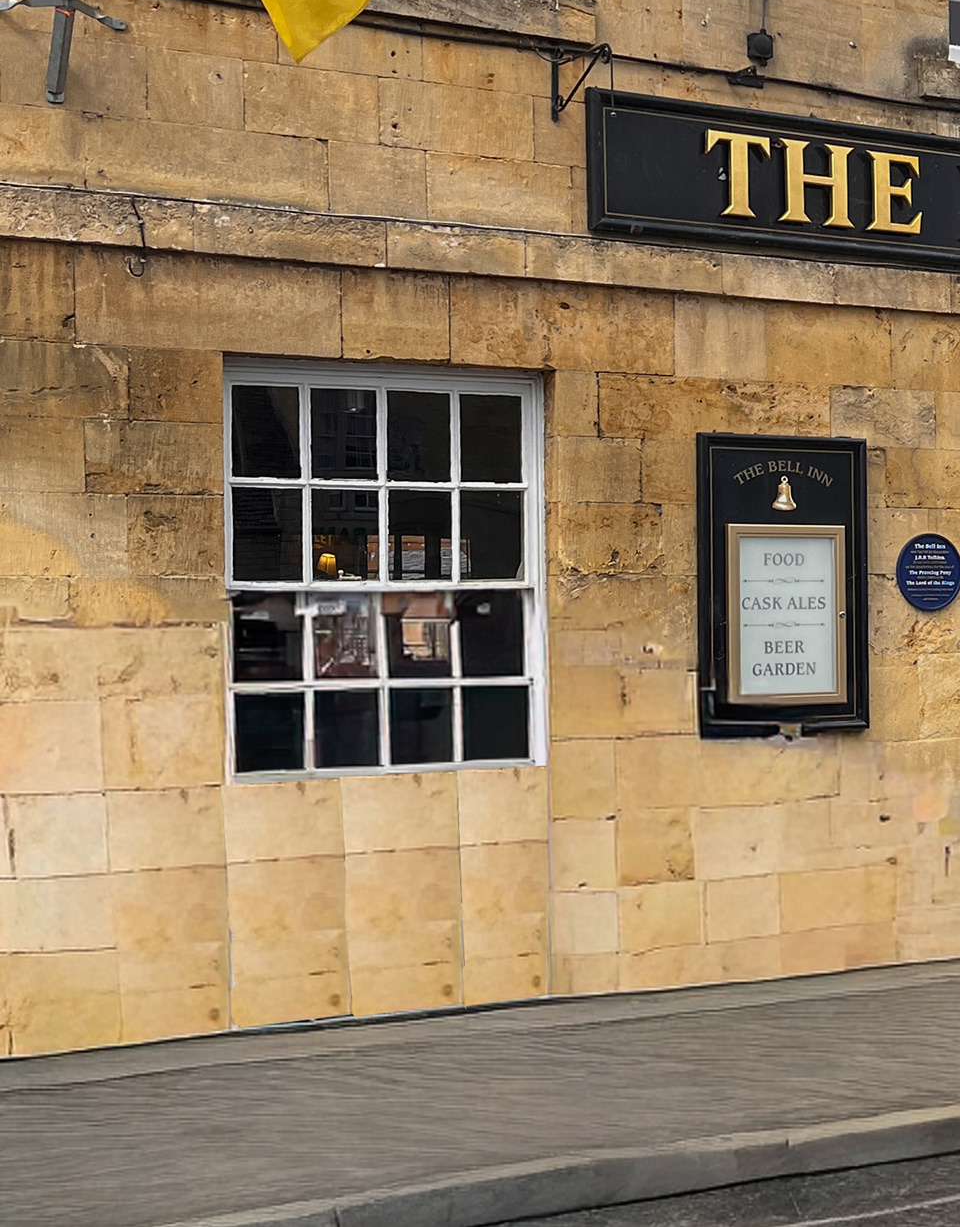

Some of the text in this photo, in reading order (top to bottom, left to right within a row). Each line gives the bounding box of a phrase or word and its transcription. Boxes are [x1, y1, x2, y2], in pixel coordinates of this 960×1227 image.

[704, 128, 923, 235] THE
[733, 460, 834, 488] THE BELL INN
[763, 553, 805, 567] FOOD
[741, 596, 826, 611] CASK ALES
[764, 640, 805, 655] BEER
[752, 662, 817, 677] GARDEN
